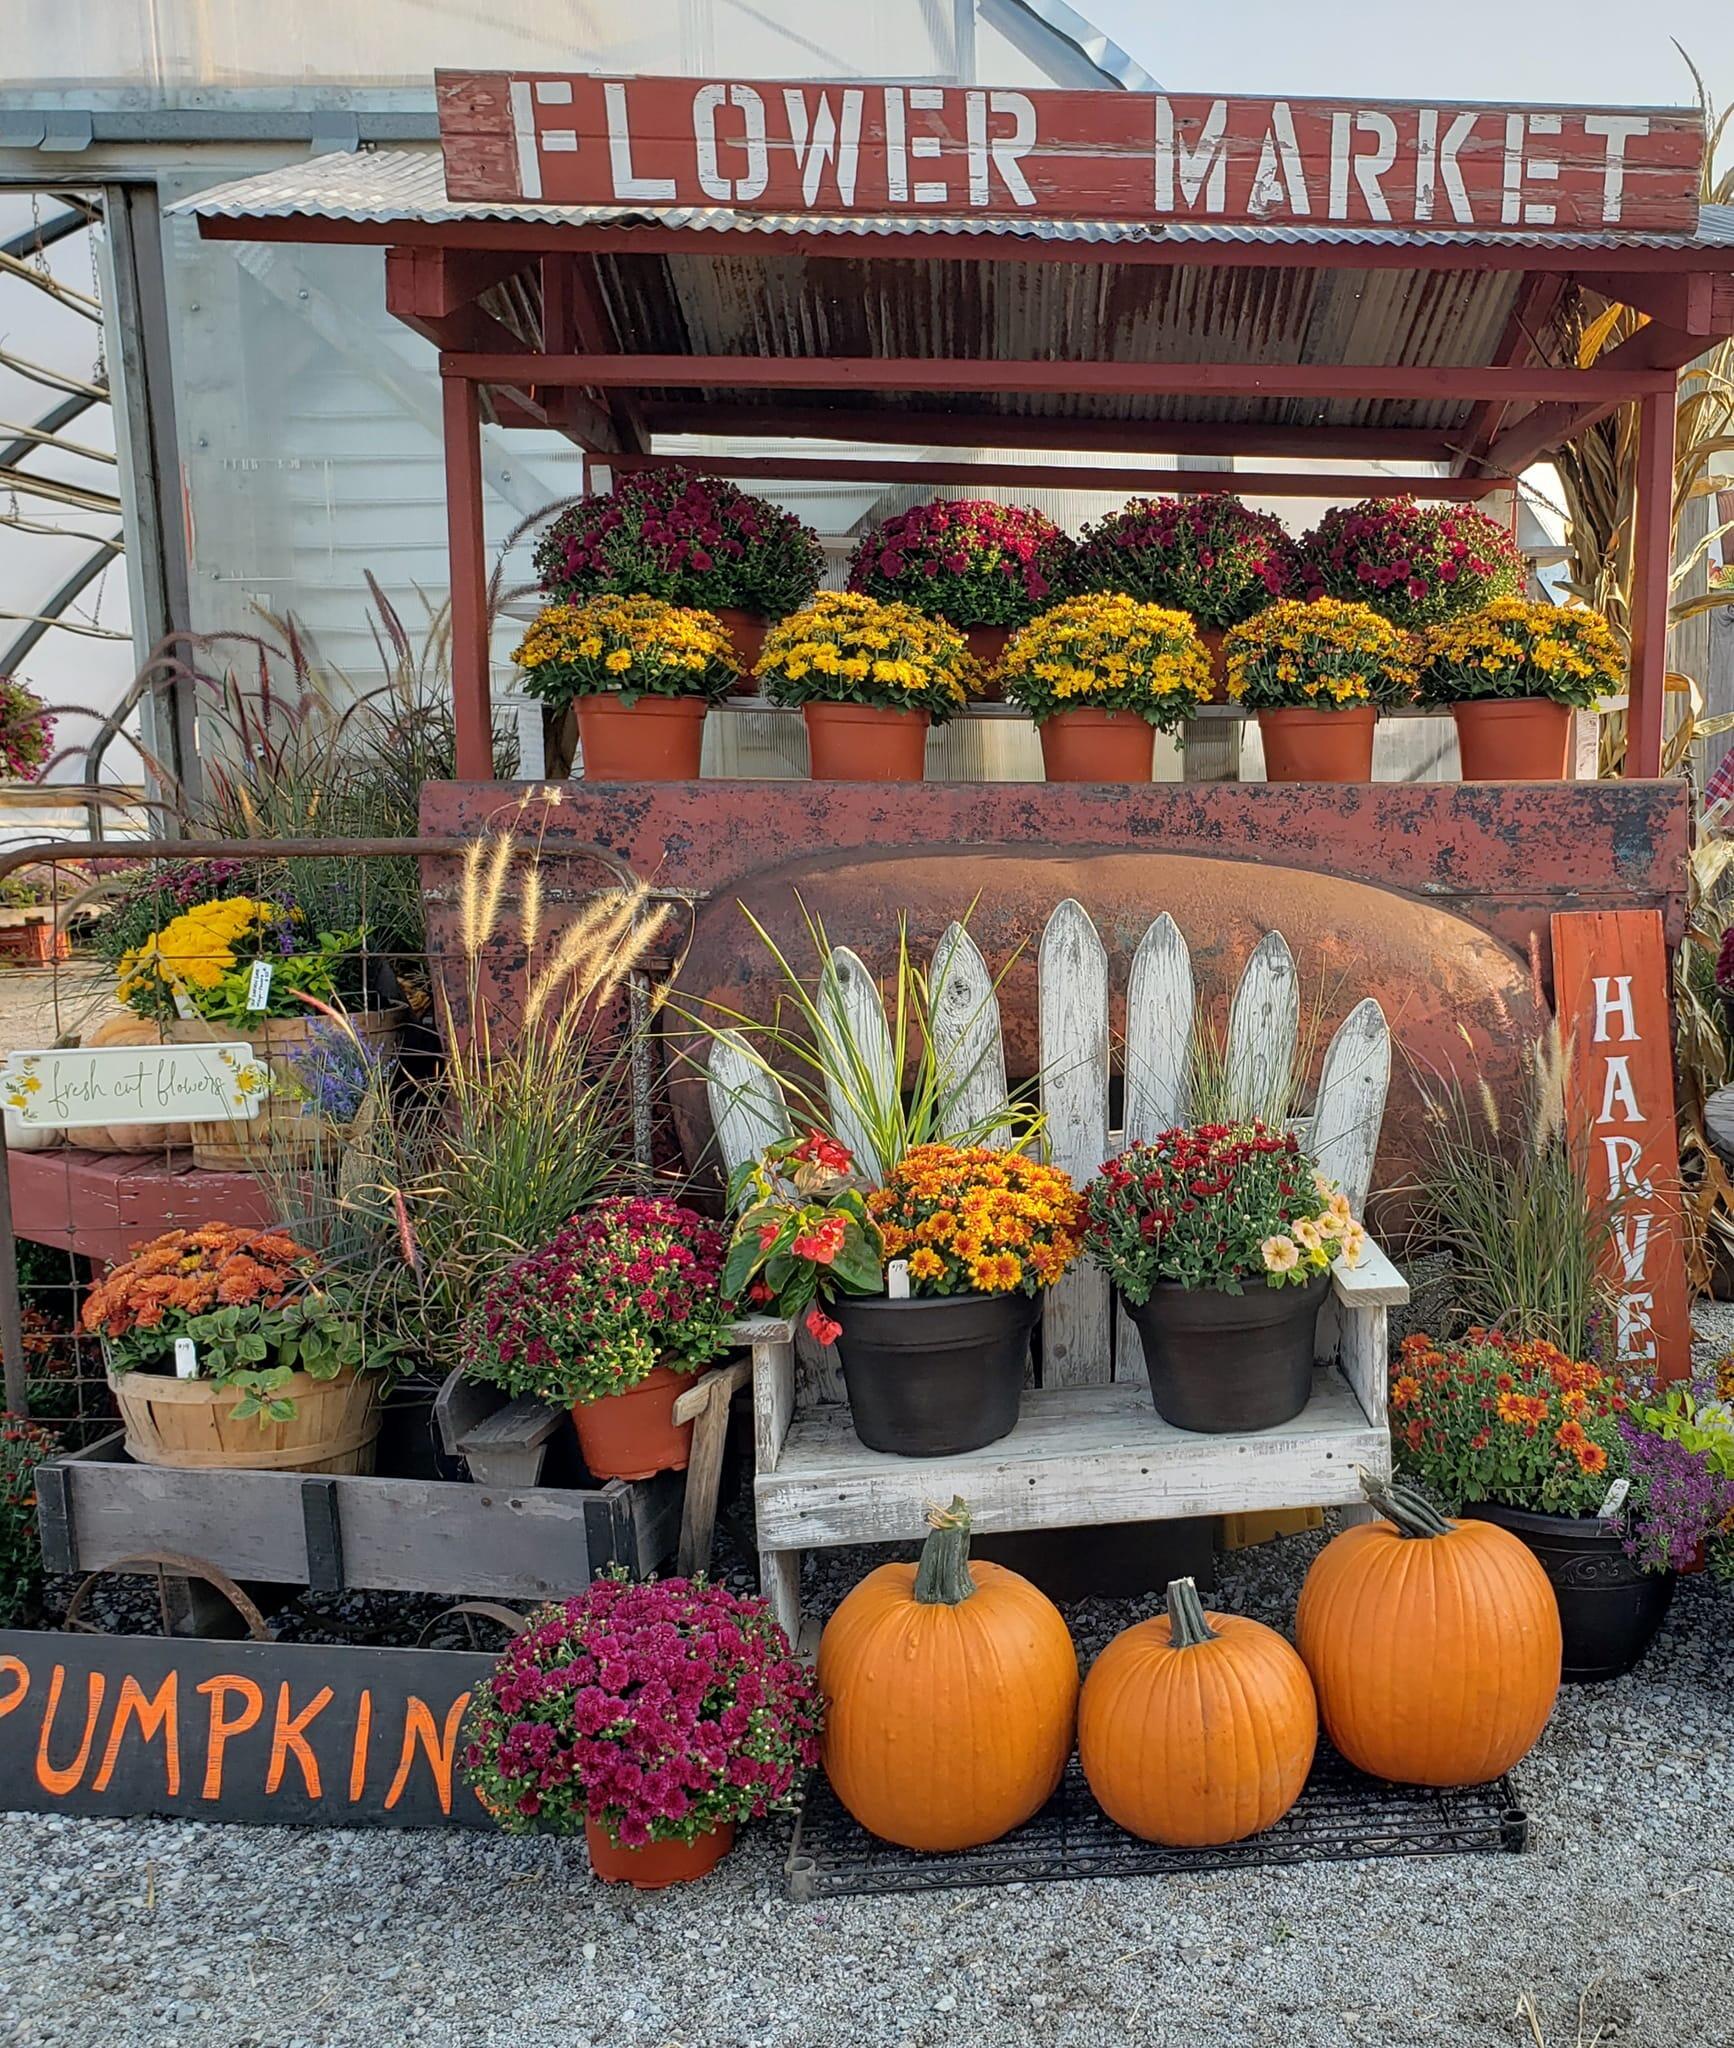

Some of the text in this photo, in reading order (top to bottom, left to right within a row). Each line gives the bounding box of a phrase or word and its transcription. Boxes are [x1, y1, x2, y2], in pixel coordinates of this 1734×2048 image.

[509, 81, 1650, 226] FLOWER MARKET
[48, 1059, 225, 1118] fresh cut flowers
[1592, 975, 1657, 1399] HARVE
